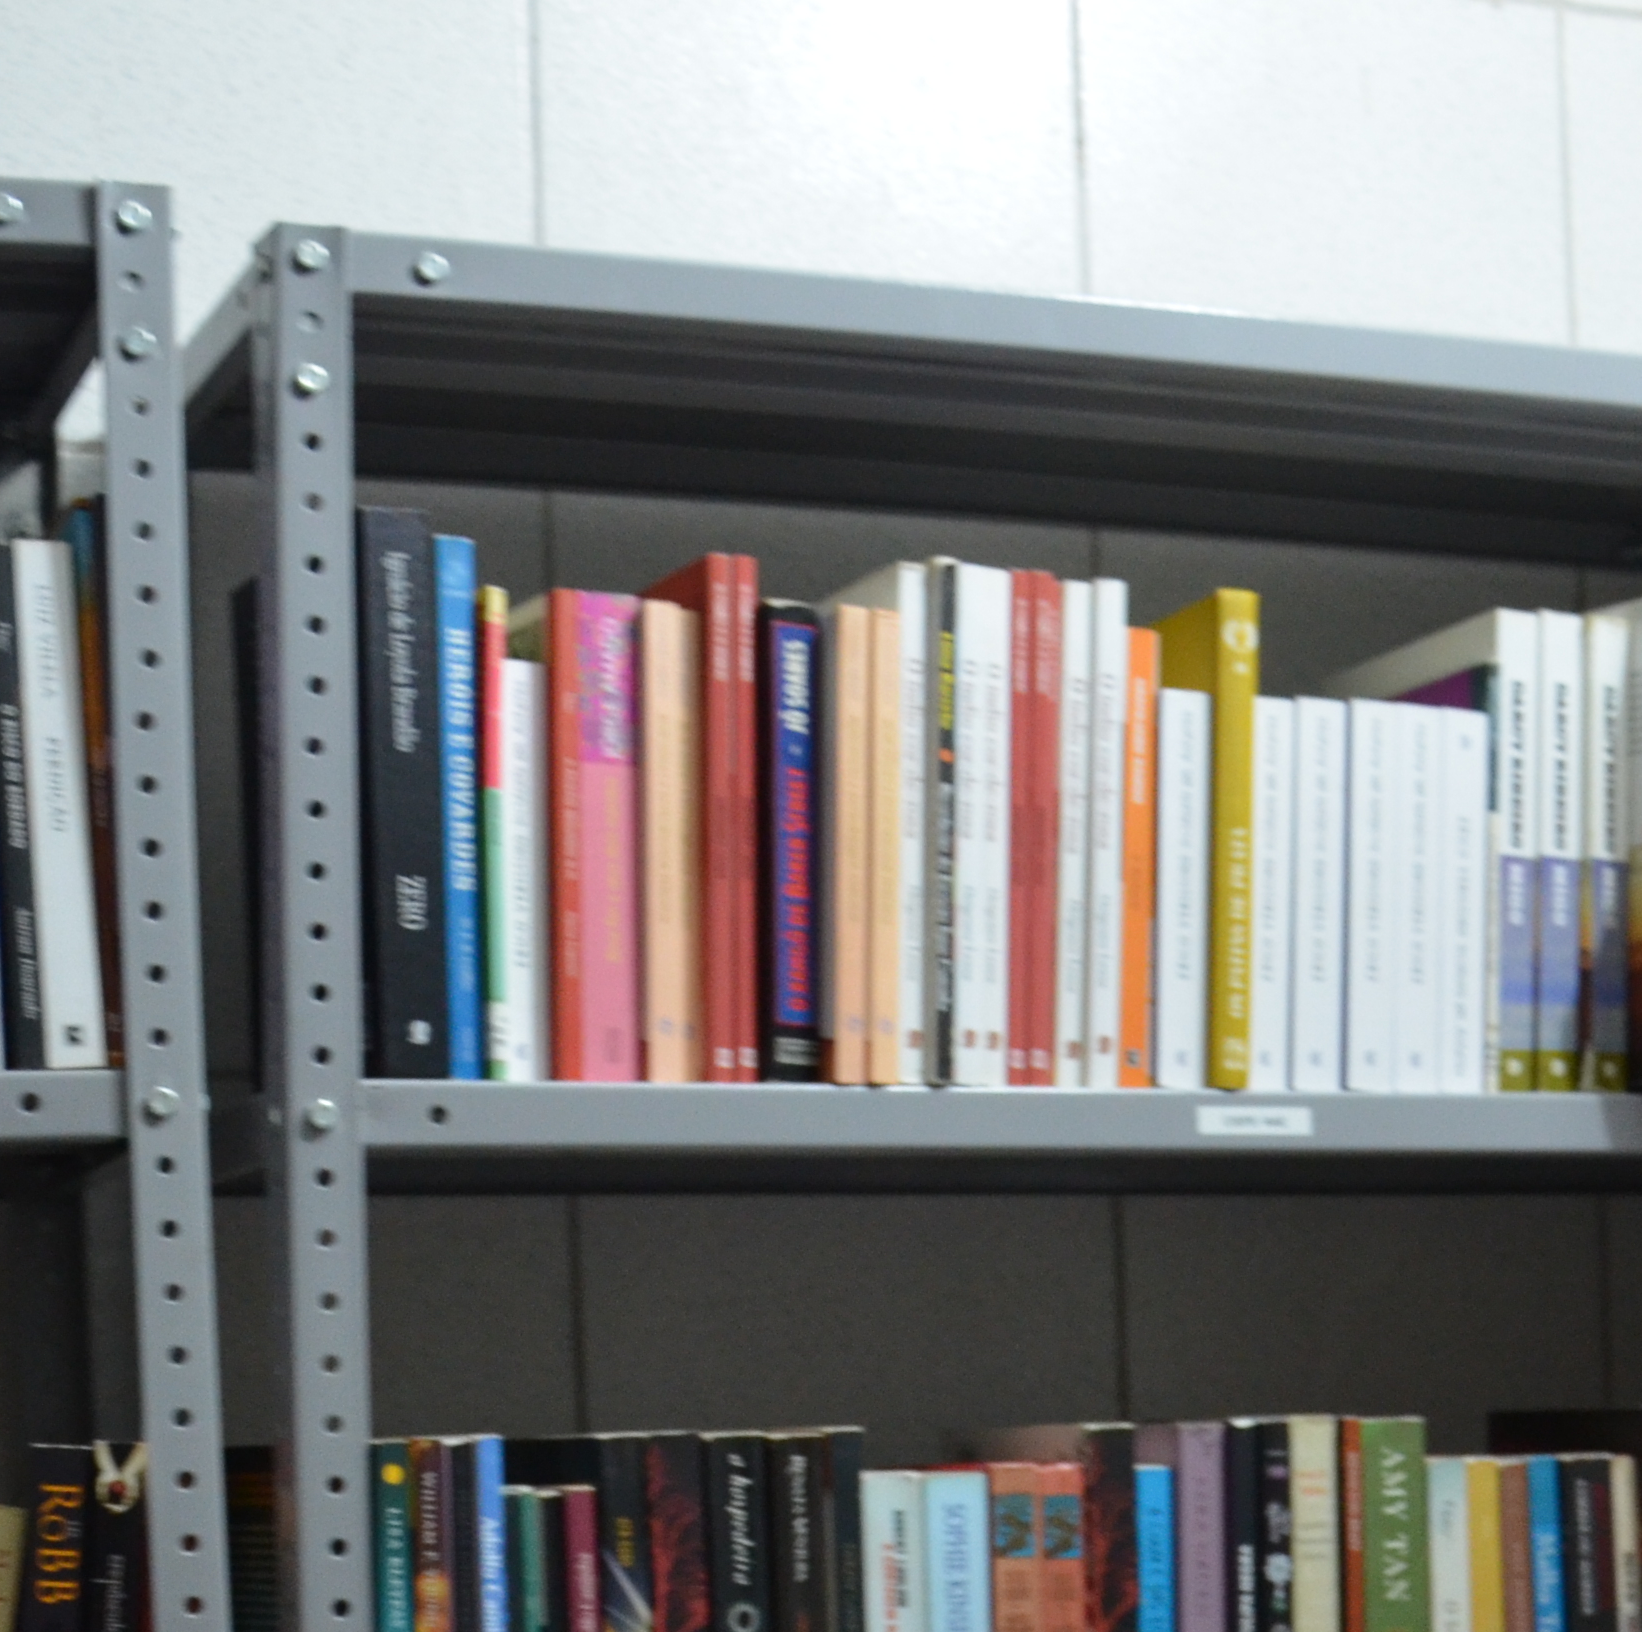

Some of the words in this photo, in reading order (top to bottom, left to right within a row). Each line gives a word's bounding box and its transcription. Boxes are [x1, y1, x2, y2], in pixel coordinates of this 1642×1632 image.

[389, 611, 413, 629] de
[383, 631, 419, 683] Loyola
[784, 640, 807, 709] SOARES
[394, 686, 423, 751] Brandão
[779, 710, 808, 735] JÔ
[451, 755, 475, 892] COVARDES
[398, 874, 426, 930] ZERO
[421, 1470, 441, 1545] WILLIAM
[1380, 1446, 1408, 1522] AMY
[387, 1507, 406, 1550] LISA
[480, 1515, 502, 1580] Adolfo
[726, 1473, 755, 1588] hospedeira
[943, 1502, 970, 1574] SOPHIE
[387, 1556, 407, 1629] KLEYPAS
[1385, 1532, 1410, 1603] TAN
[1533, 1530, 1556, 1606] Malba
